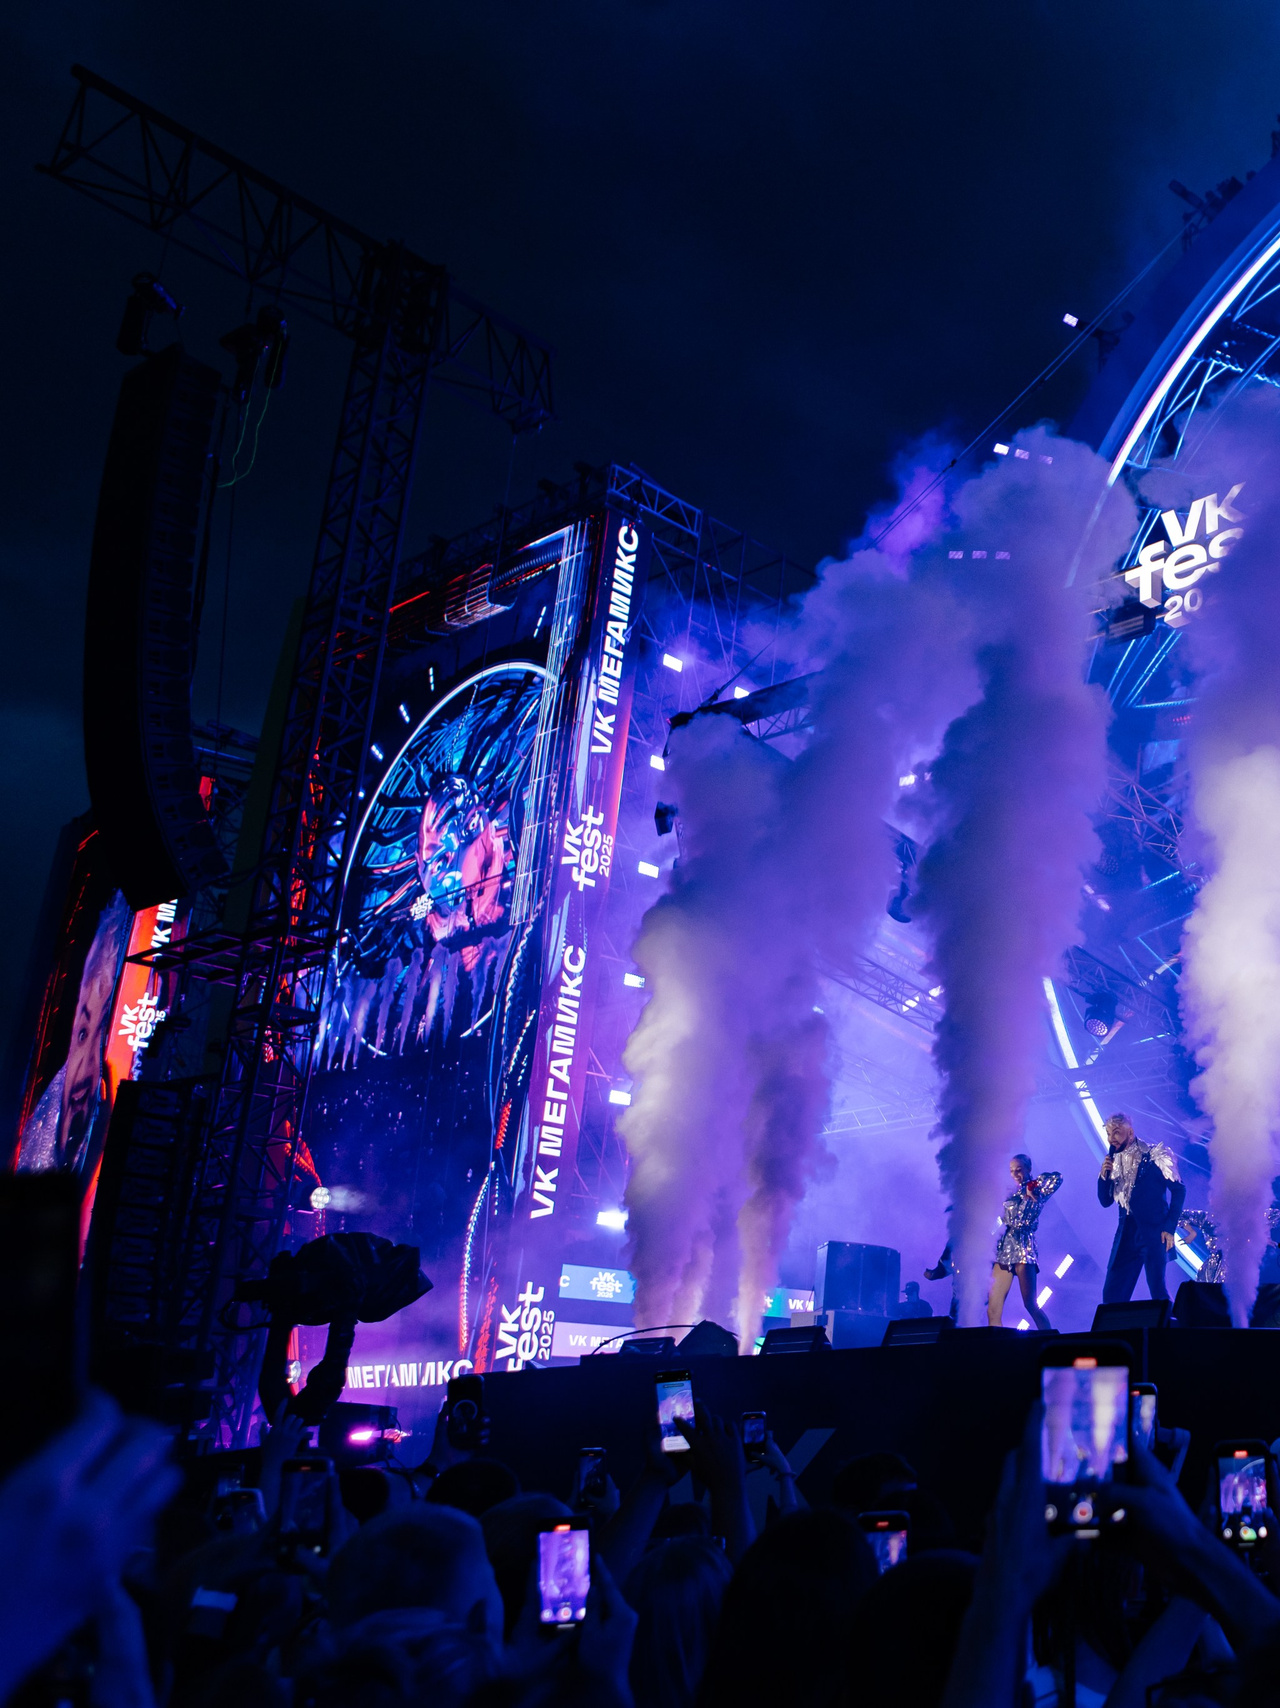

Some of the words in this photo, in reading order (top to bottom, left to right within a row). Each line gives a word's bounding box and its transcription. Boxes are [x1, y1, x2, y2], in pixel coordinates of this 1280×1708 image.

[1161, 481, 1246, 547] VK
[1125, 527, 1245, 608] fes
[598, 525, 639, 706] МЕГАМИКС
[1163, 588, 1204, 628] 20
[591, 707, 616, 755] VK
[561, 819, 584, 865] VK
[572, 805, 604, 892] fest
[600, 834, 613, 878] 2025
[118, 1003, 140, 1036] VK
[127, 992, 159, 1052] fest
[539, 945, 586, 1158] МЕГАМИКС
[530, 1165, 559, 1219] VK
[590, 1277, 623, 1293] fest
[598, 1271, 616, 1282] VK
[788, 1298, 804, 1310] VK
[495, 1304, 522, 1360] VK
[538, 1310, 555, 1360] 2025
[569, 1334, 587, 1347] VK
